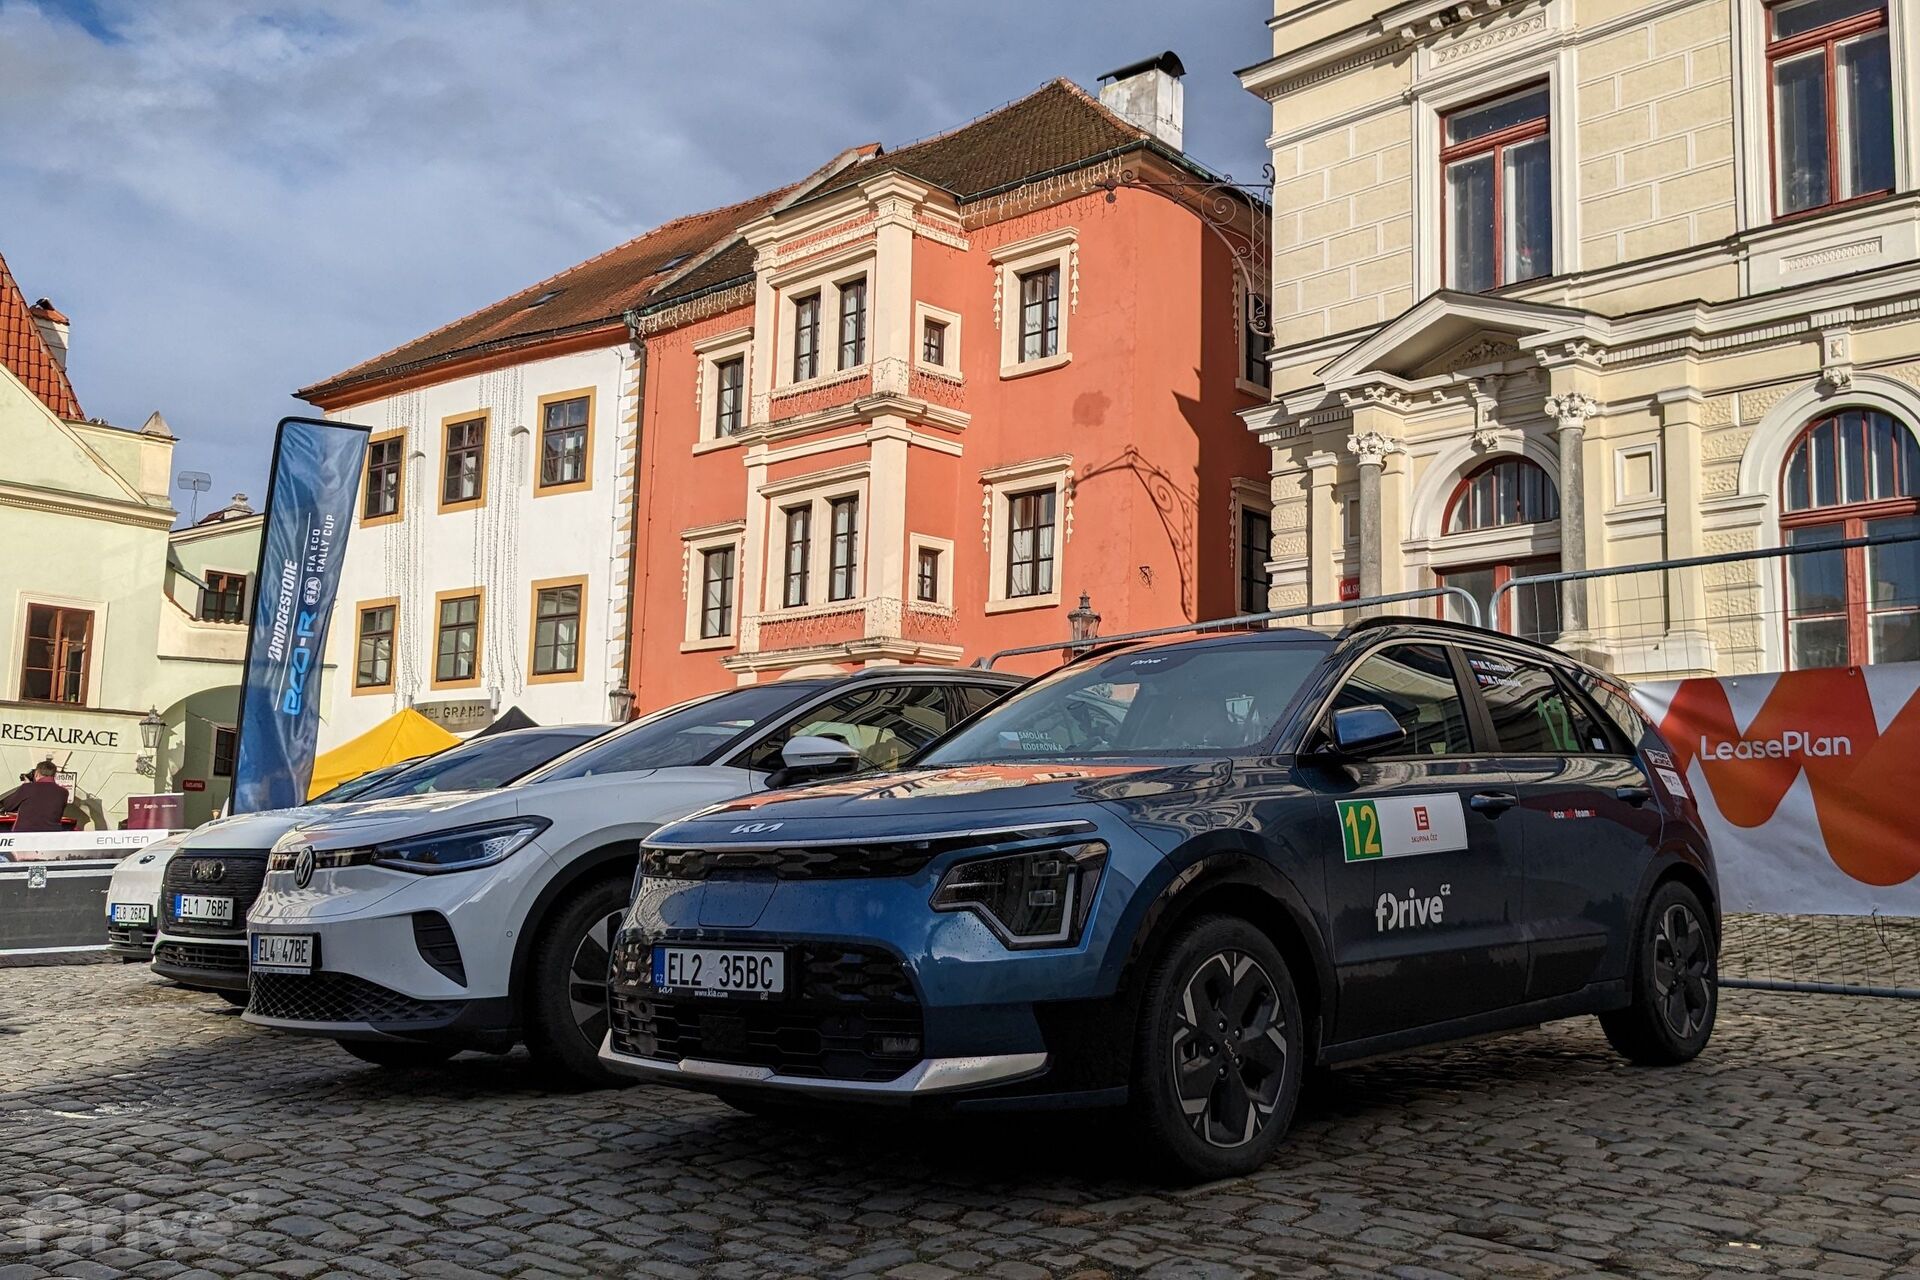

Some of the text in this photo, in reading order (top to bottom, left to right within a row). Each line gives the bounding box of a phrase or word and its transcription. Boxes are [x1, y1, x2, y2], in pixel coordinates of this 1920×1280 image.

[307, 529, 321, 572] FIA ECO
[317, 513, 335, 573] RALLY CUP
[304, 577, 322, 605] FIA
[267, 558, 298, 662] BRIDGESTONE
[443, 705, 486, 718] GRAND
[1, 723, 119, 747] RESTAURACE
[1700, 730, 1852, 760] LeasePlan
[96, 835, 149, 845] ENLITEN
[729, 822, 785, 834] KIA
[1345, 805, 1381, 856] 12
[1411, 834, 1430, 843] SKUPINA
[130, 907, 147, 920] 26AZ
[182, 898, 229, 917] EL1 76BF
[259, 938, 309, 963] EL4 47BE
[655, 973, 664, 984] CZ
[668, 952, 773, 989] EL2 35BC
[694, 988, 729, 998] www.kia.com
